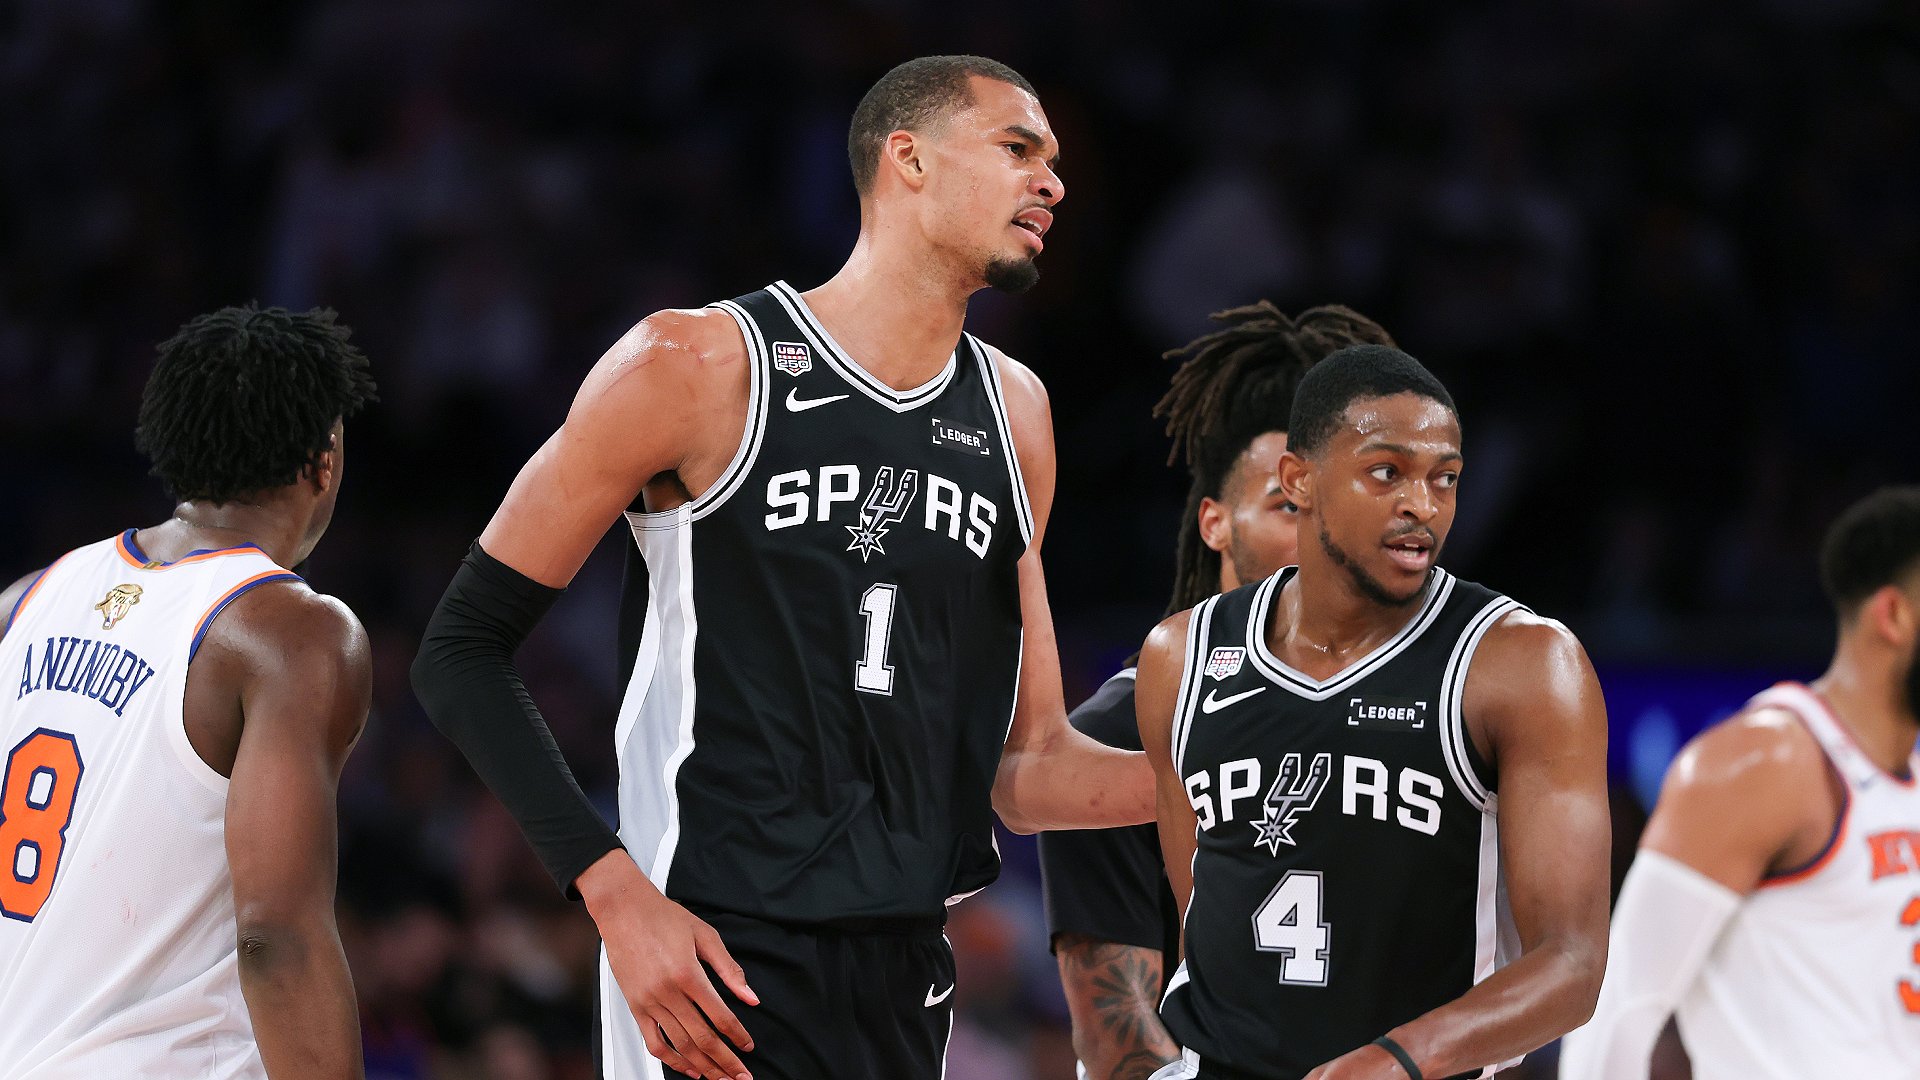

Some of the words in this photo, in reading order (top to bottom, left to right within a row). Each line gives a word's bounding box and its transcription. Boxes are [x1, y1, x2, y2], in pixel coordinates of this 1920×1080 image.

[777, 346, 806, 355] USA
[777, 359, 809, 369] 250
[939, 426, 981, 448] LEDGER
[765, 464, 997, 563] SPURS
[17, 636, 155, 718] ANUNOBY
[854, 582, 898, 697] 1
[1215, 651, 1240, 660] USA
[1358, 705, 1416, 720] LEDGER
[0, 726, 85, 924] 8
[1184, 752, 1444, 858] SPURS
[1250, 869, 1332, 987] 4
